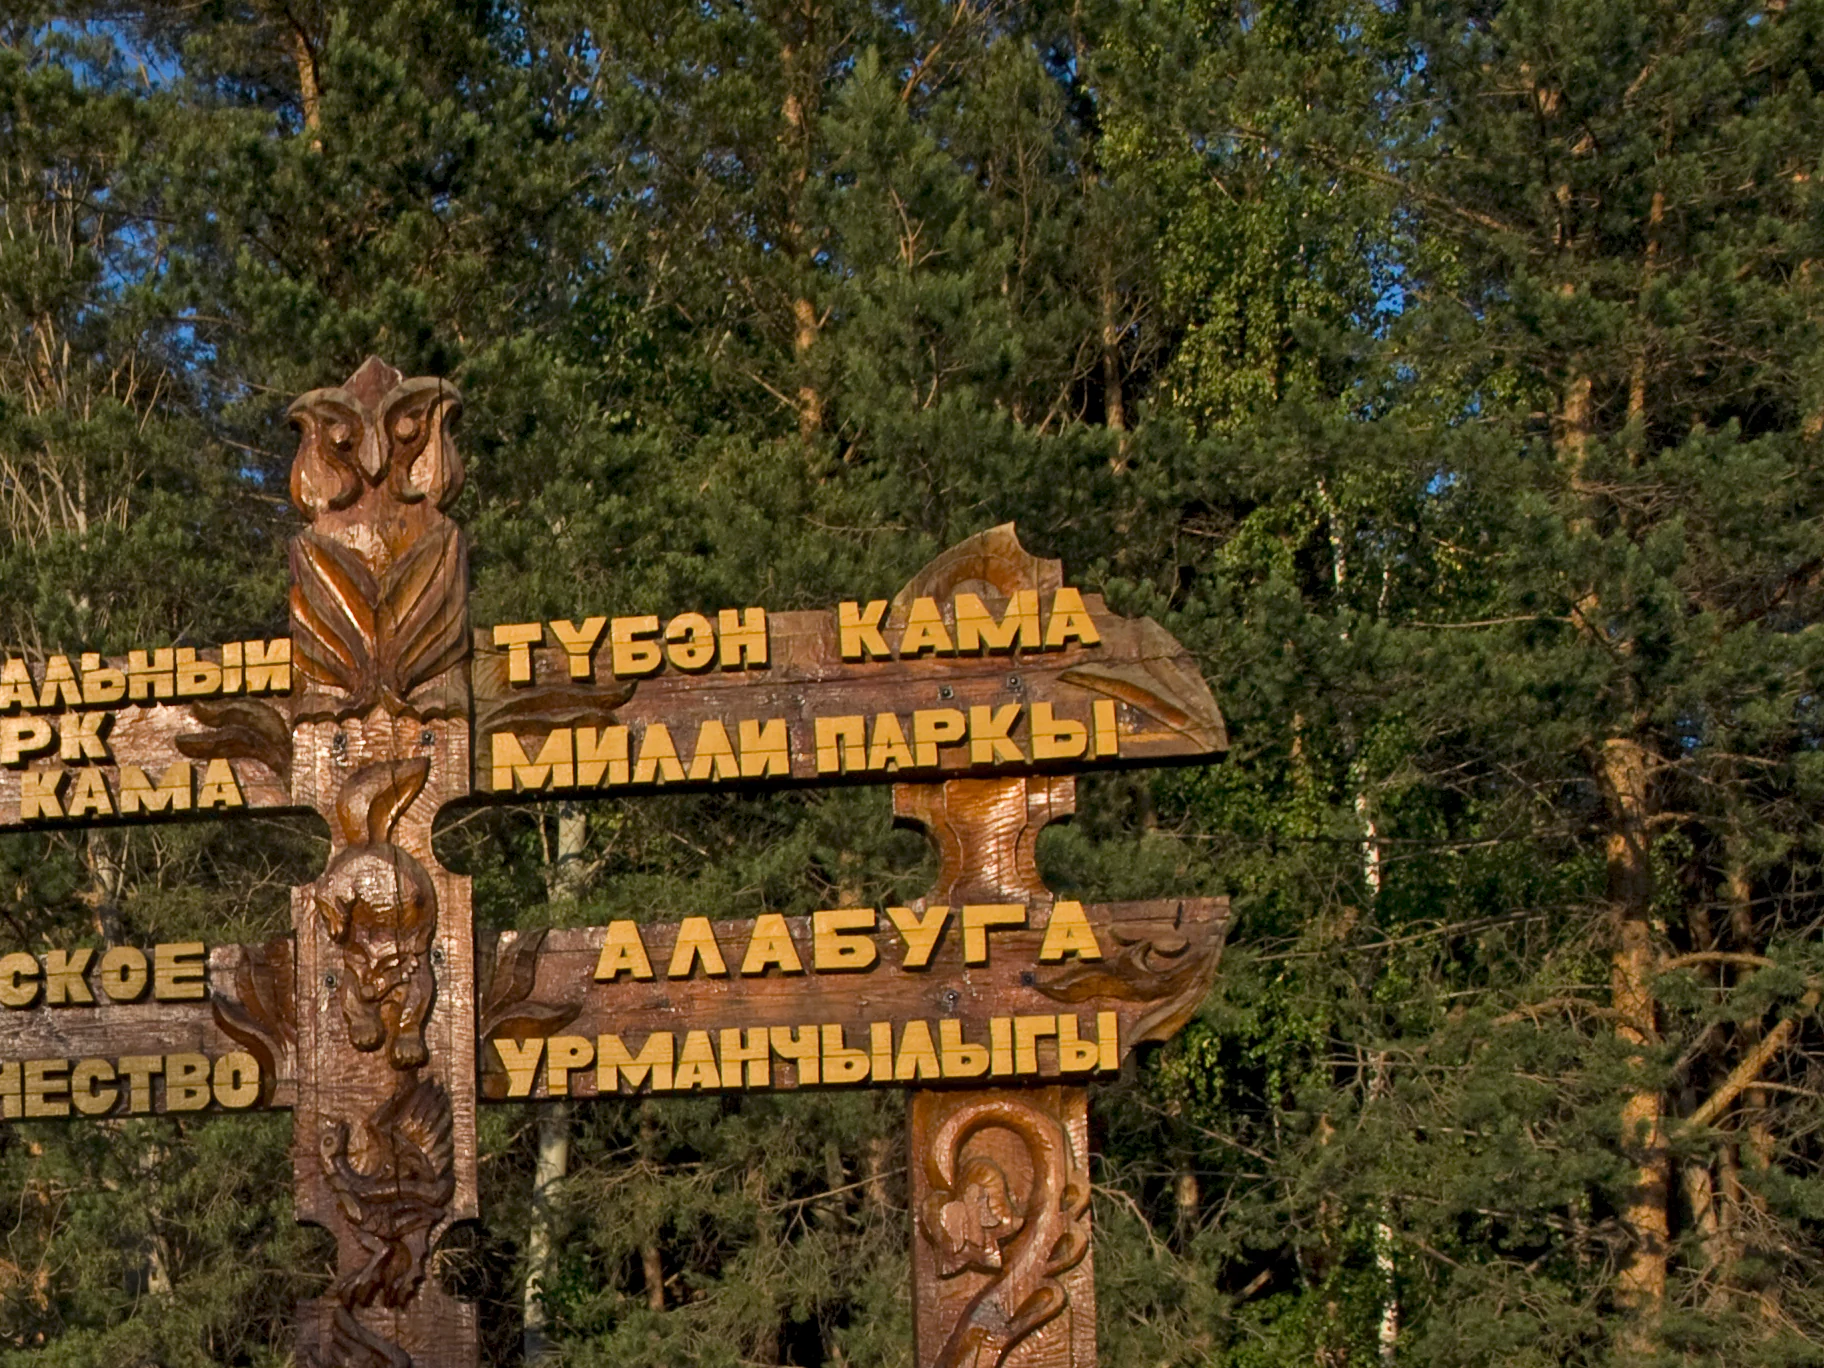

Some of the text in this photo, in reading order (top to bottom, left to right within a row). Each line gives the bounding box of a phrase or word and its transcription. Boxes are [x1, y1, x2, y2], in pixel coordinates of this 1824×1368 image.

[838, 588, 1102, 660] КАМА
[492, 699, 1119, 791] МИЛЛИ ПАРКЫ
[20, 758, 246, 822] КАМА
[594, 901, 1102, 982] АЛАБУГА
[494, 1011, 1119, 1097] УРМАНЧЫЛЫГЫ
